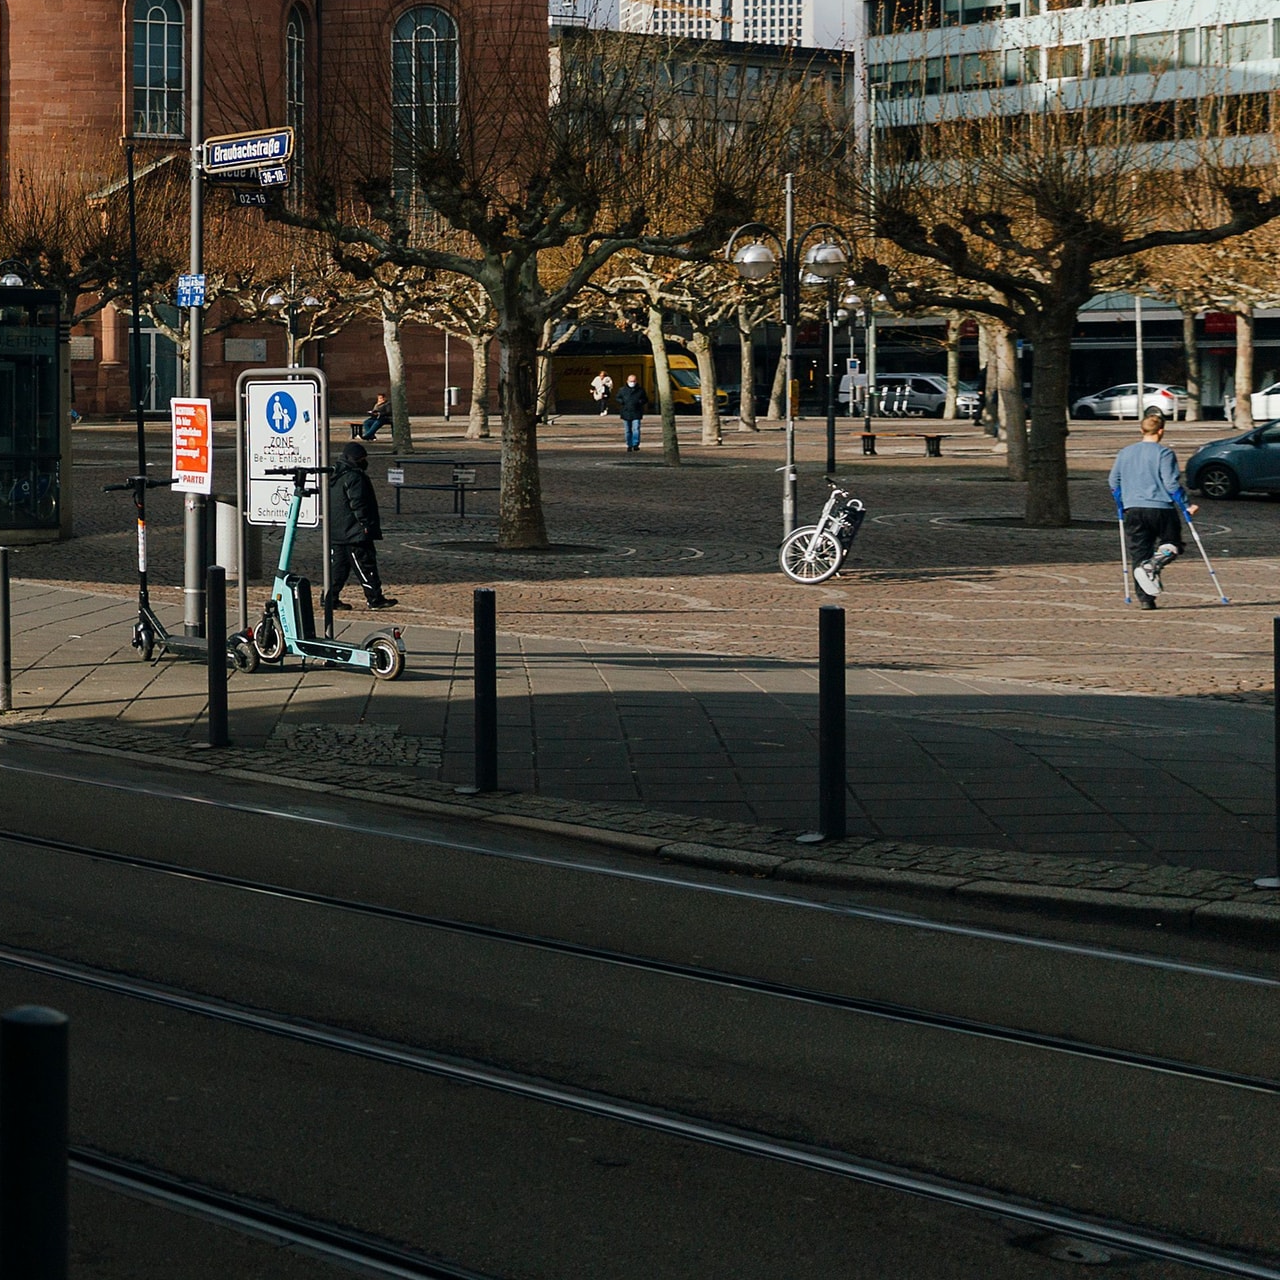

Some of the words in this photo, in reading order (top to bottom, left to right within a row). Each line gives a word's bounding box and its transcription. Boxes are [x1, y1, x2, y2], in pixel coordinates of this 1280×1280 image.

[213, 138, 281, 163] Braubachstraße
[239, 193, 266, 204] 02-16
[270, 436, 294, 447] ZONE
[254, 453, 266, 462] Be-
[278, 454, 312, 464] Entladen
[182, 474, 205, 484] PARTEI
[257, 507, 309, 519] Schrittteo!
